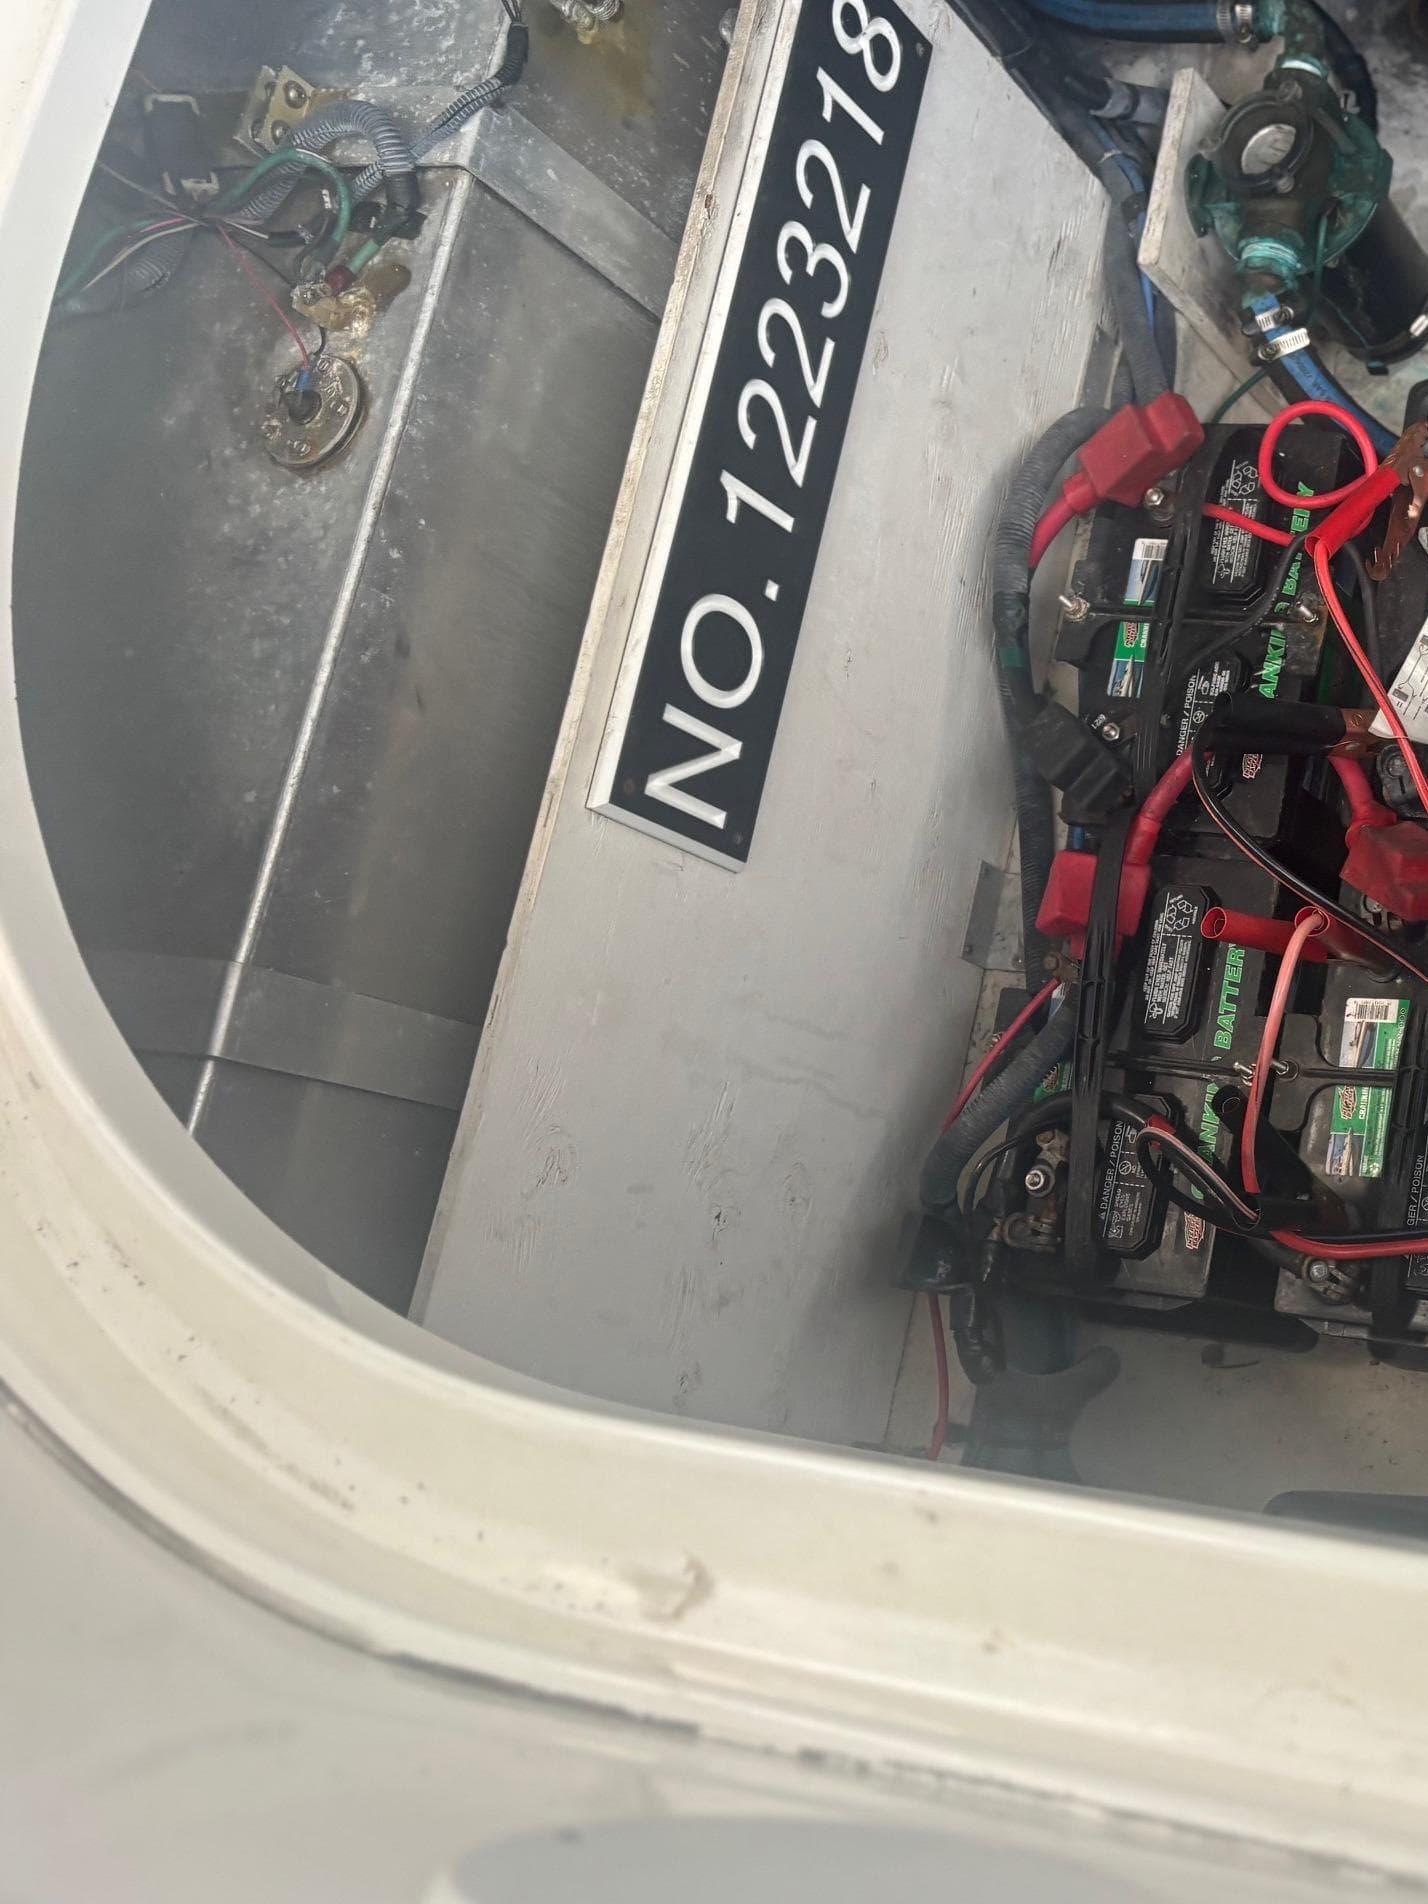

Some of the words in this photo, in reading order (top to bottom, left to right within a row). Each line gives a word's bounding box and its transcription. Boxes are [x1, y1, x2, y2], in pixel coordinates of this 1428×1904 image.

[643, 580, 780, 831] NO.
[720, 0, 904, 535] 1223218
[1213, 946, 1245, 1051] BATTER
[1100, 1169, 1114, 1209] DANGER
[1110, 1121, 1123, 1157] POISON
[1407, 1205, 1417, 1225] GER
[1412, 1154, 1427, 1193] POISON
